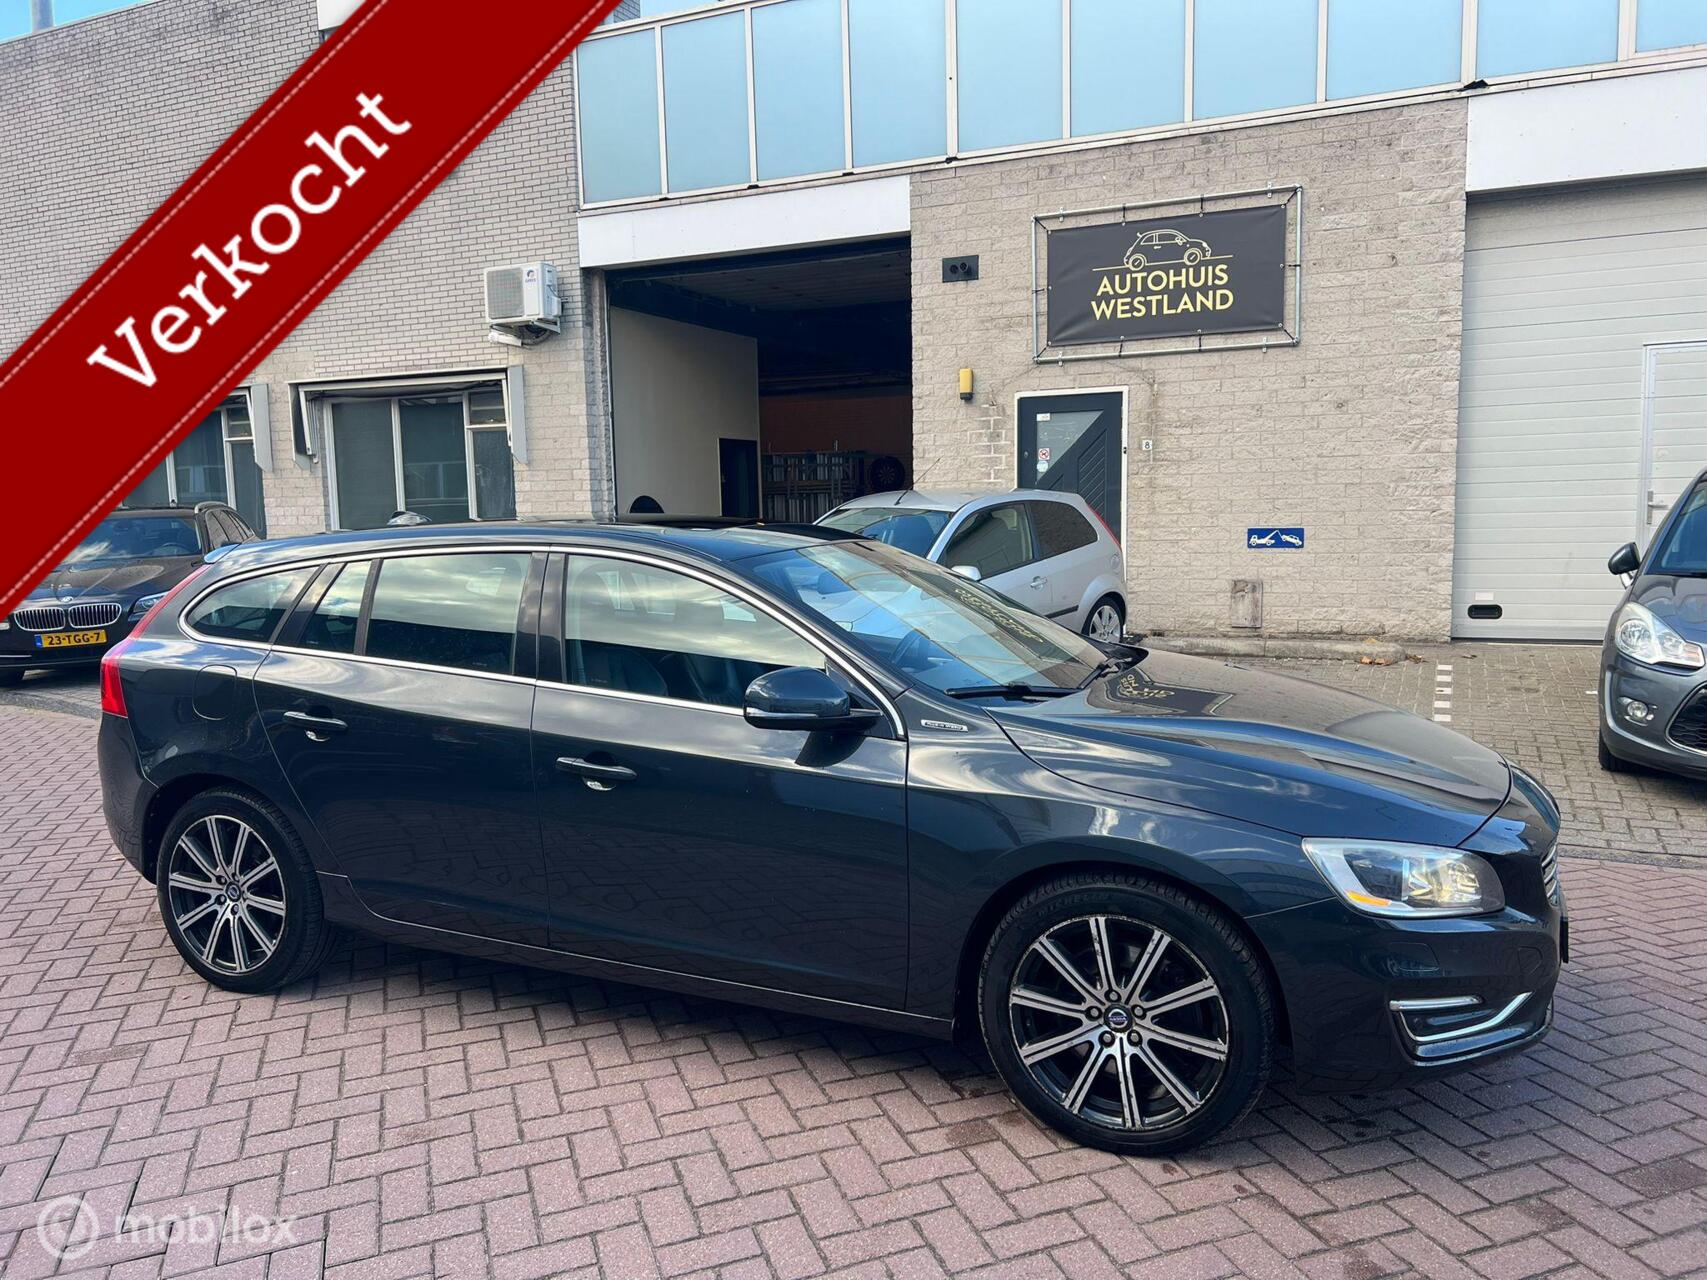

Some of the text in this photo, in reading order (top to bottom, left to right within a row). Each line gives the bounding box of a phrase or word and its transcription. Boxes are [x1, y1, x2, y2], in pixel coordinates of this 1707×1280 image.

[1096, 264, 1228, 296] AUTOHUIS
[1091, 289, 1234, 320] WESTLAND
[1144, 441, 1151, 450] 8
[47, 632, 101, 646] 23-TGG-7
